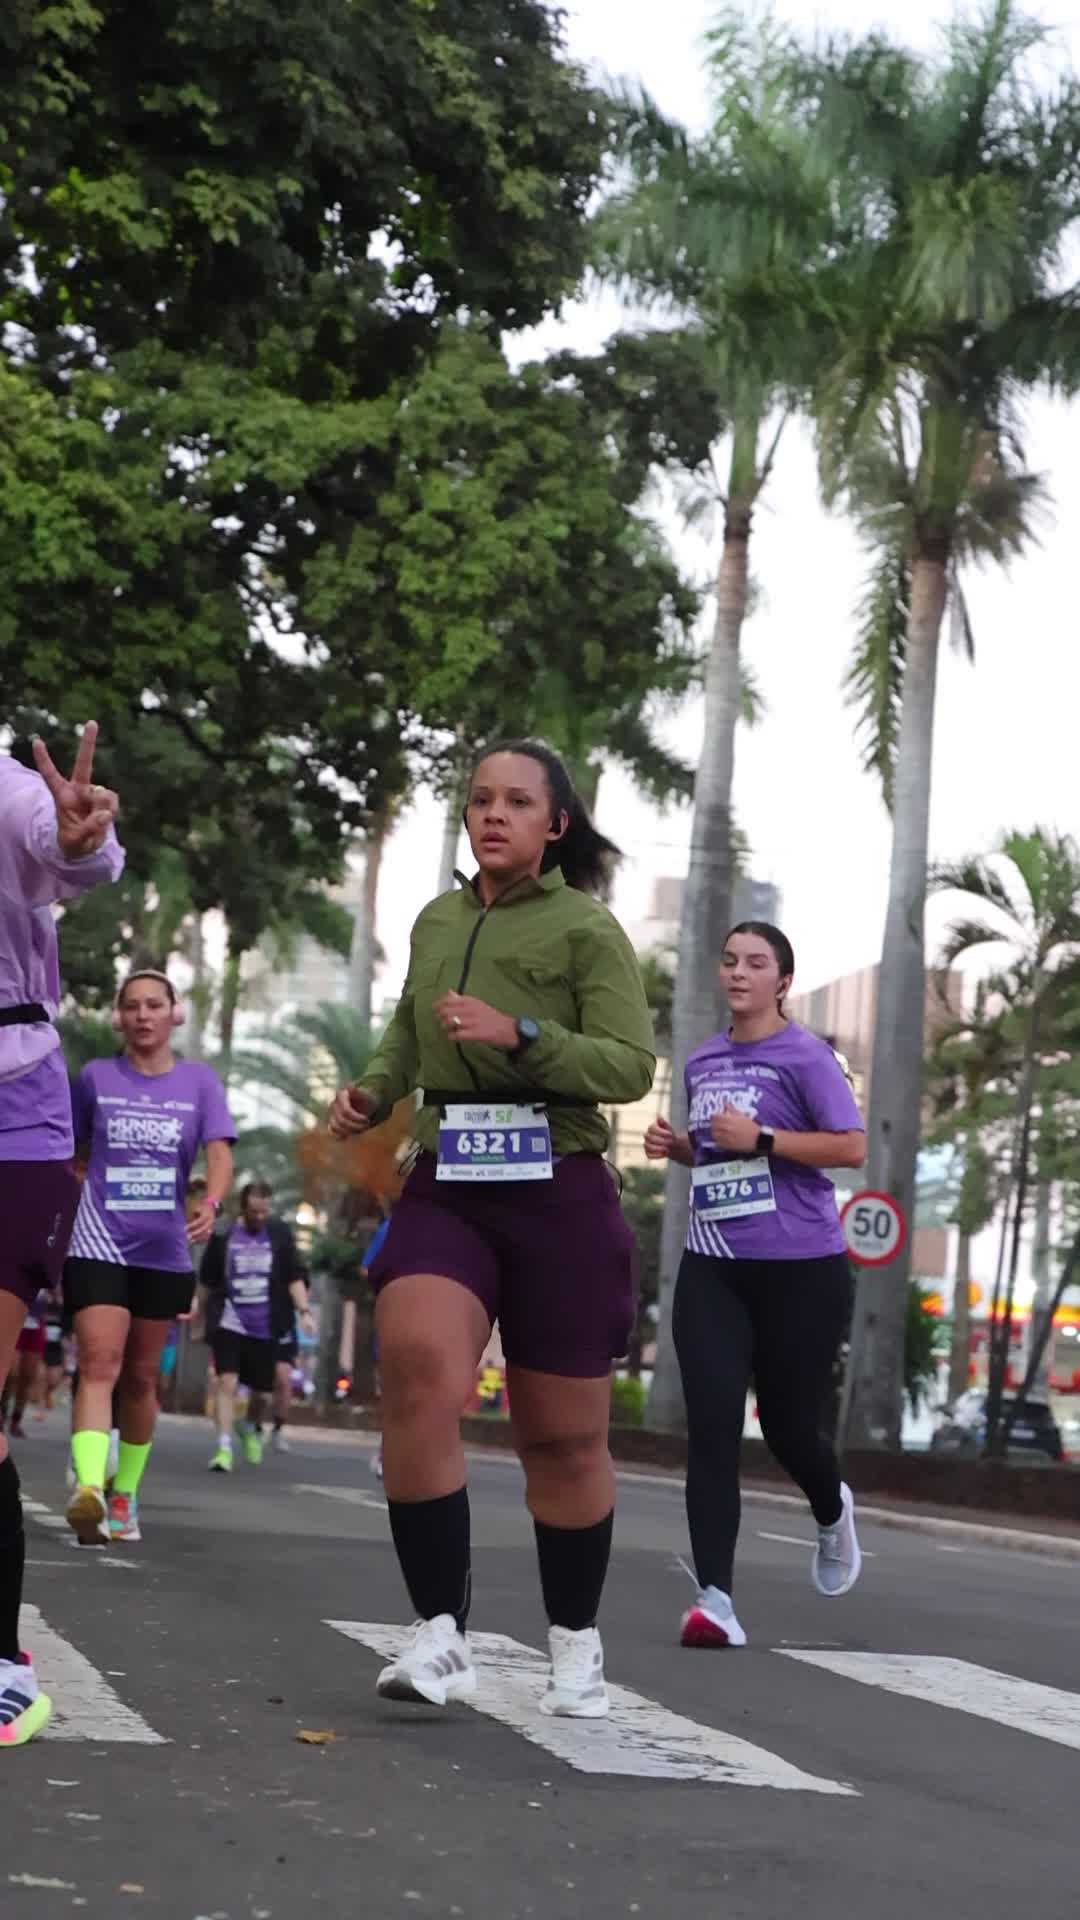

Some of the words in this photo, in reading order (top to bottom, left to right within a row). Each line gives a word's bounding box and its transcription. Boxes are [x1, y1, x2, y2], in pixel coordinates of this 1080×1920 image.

[457, 1132, 520, 1154] 6321
[120, 1183, 160, 1196] 5002
[706, 1179, 752, 1201] 5276
[853, 1207, 891, 1239] 50
